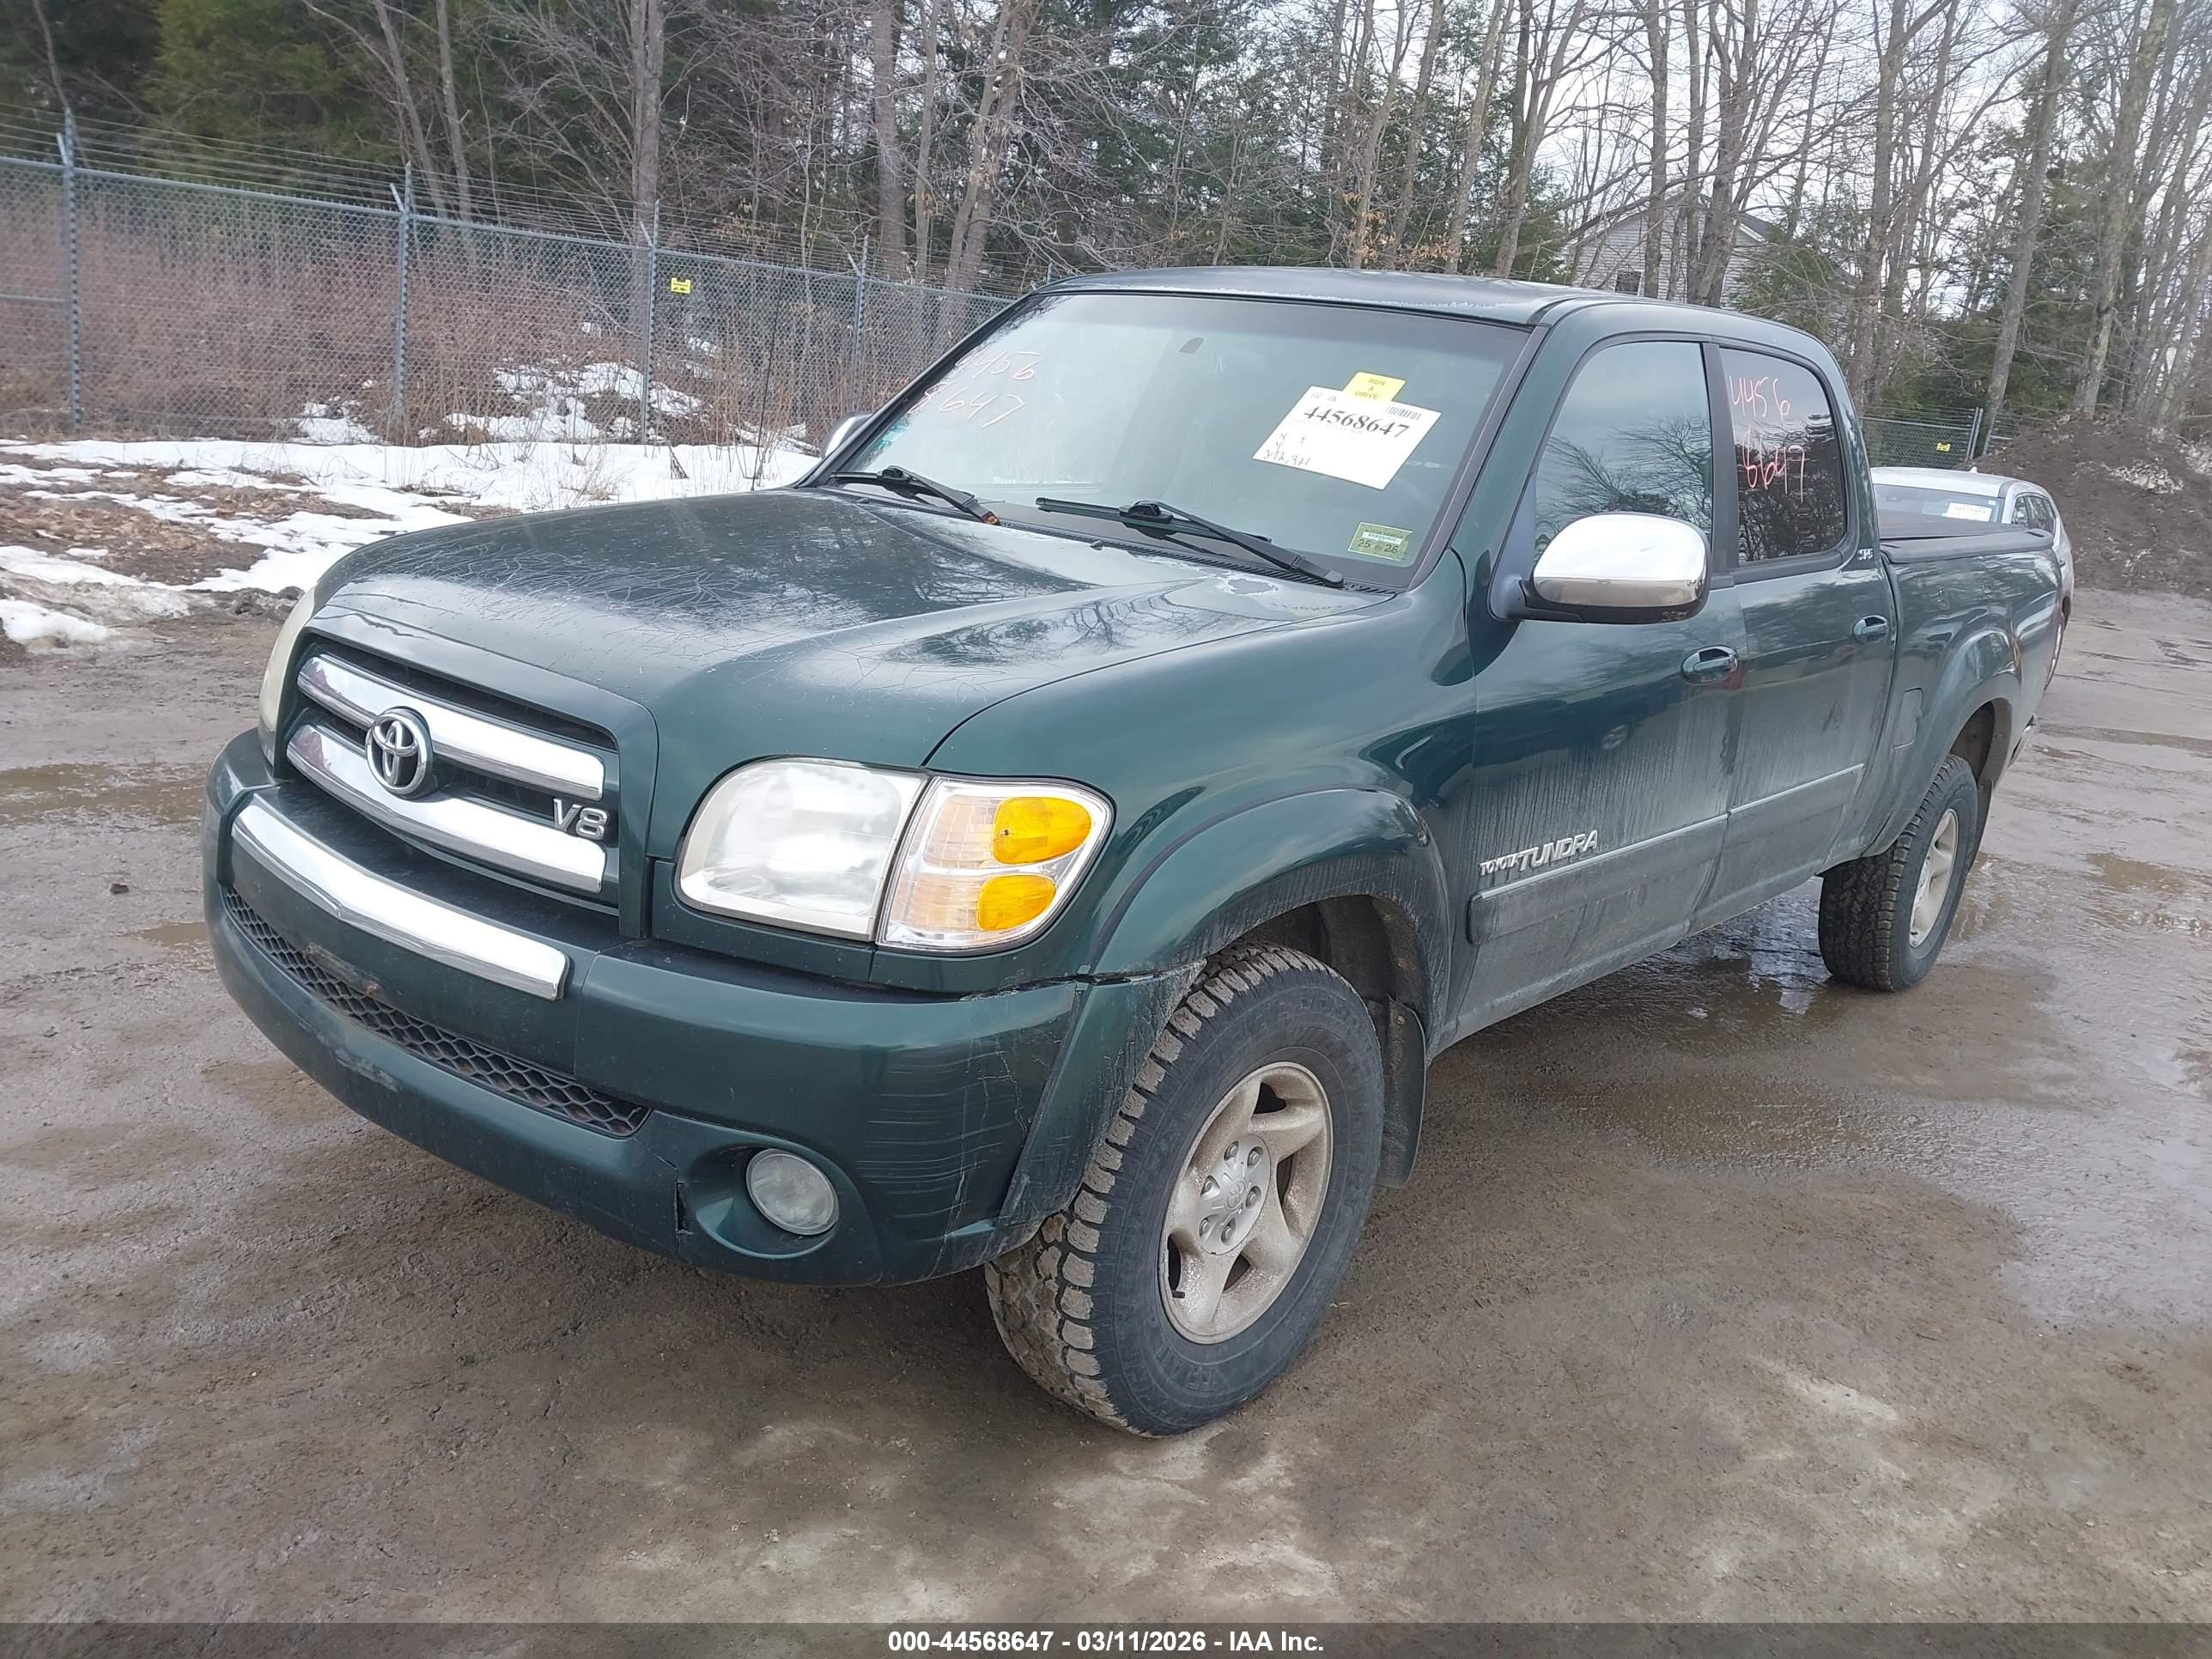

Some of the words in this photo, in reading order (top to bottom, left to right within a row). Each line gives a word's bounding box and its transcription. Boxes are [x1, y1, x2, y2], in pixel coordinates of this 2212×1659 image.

[908, 380, 1024, 428] 8647
[1354, 391, 1380, 400] DRIVE
[1729, 375, 1791, 420] 4456
[1304, 405, 1411, 438] 44568647
[1742, 426, 1806, 504] 8647
[1357, 538, 1372, 549] 25
[1384, 544, 1400, 554] 26
[553, 798, 608, 840] V8
[1479, 853, 1519, 876] TOYOTA
[1517, 830, 1599, 872] TUNDRA
